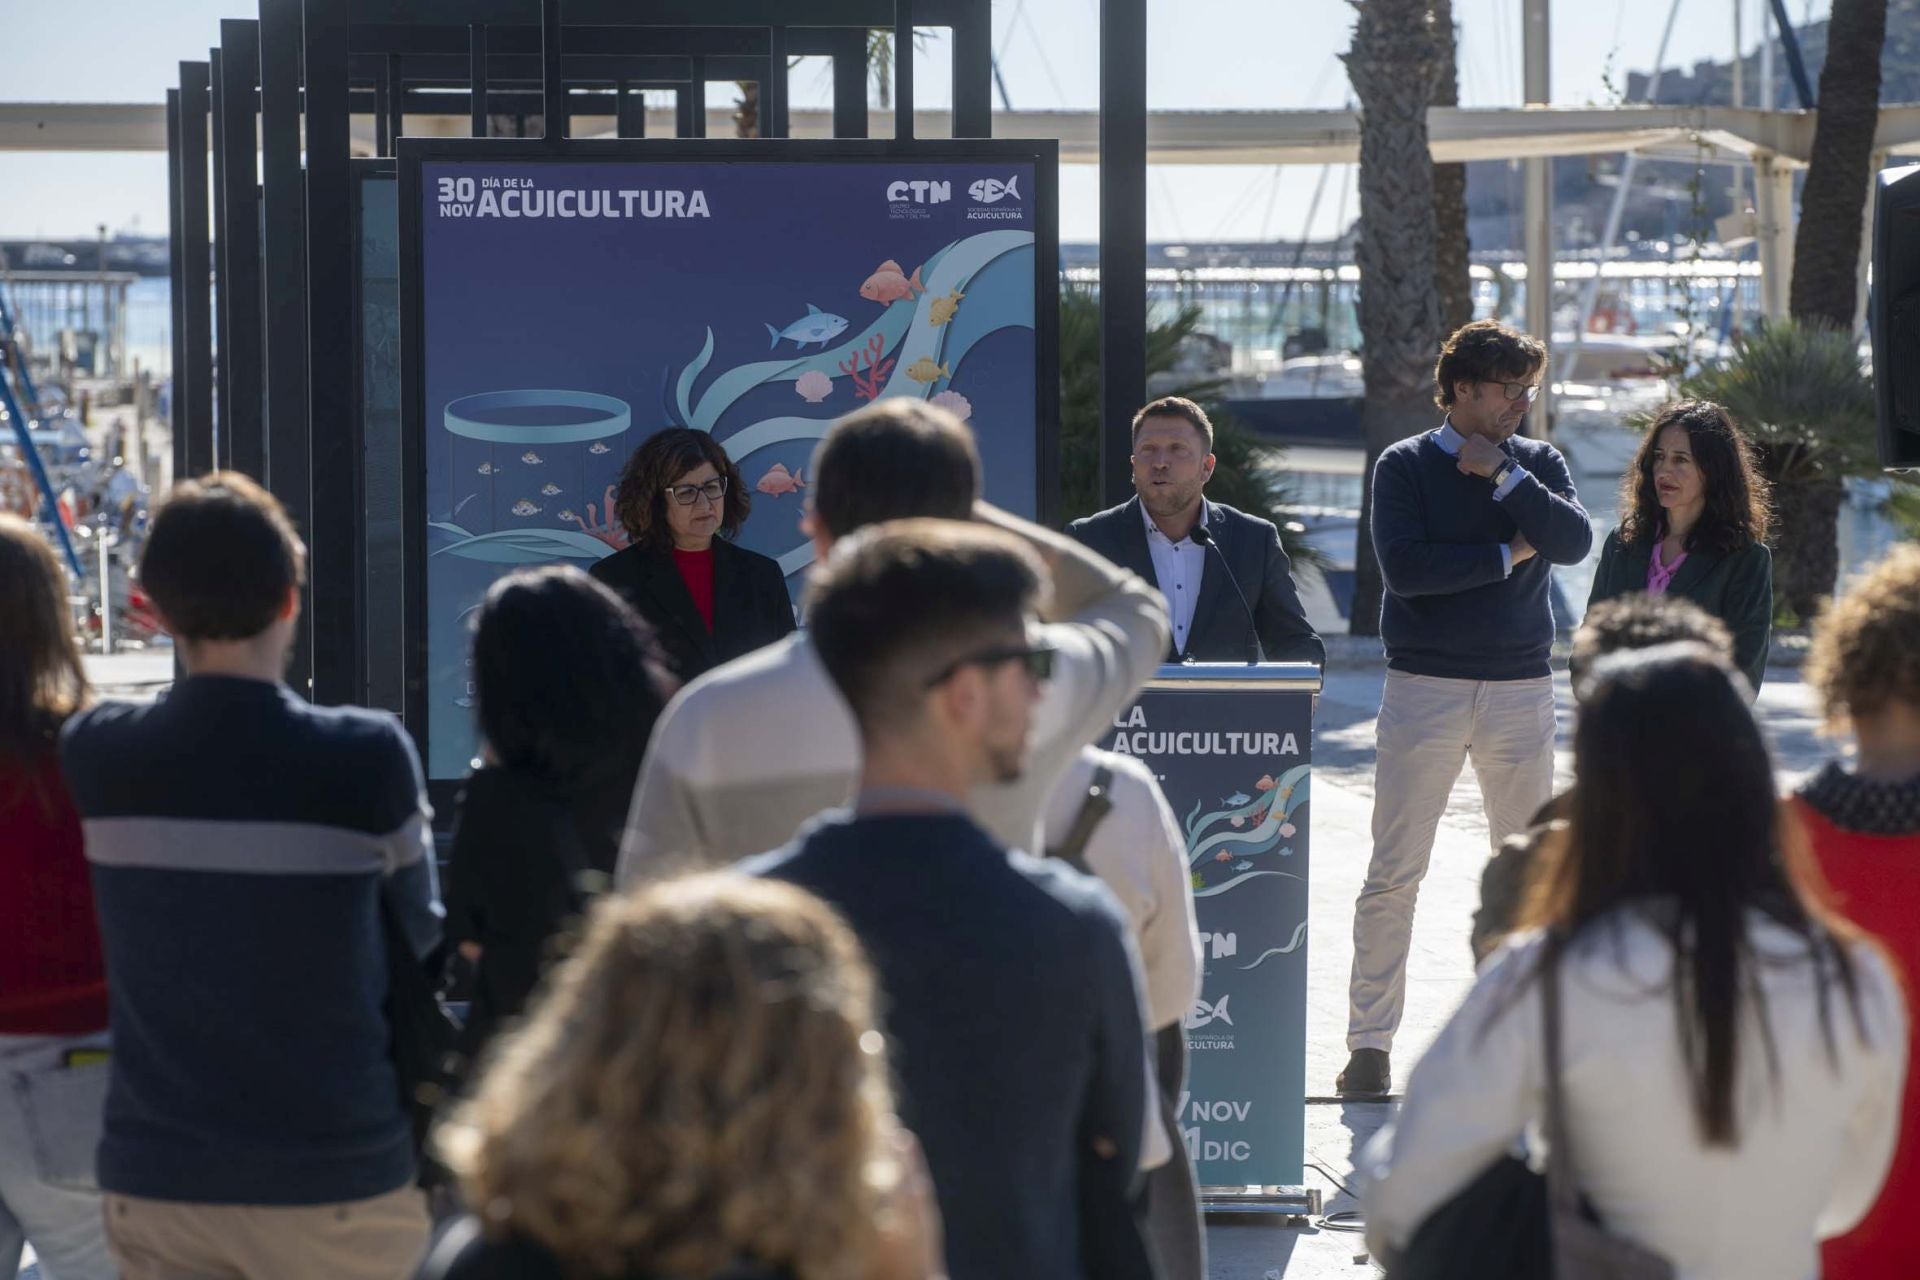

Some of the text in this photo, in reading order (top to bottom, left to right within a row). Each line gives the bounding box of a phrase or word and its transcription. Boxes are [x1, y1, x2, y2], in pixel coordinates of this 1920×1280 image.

[438, 177, 475, 202] 30
[481, 176, 534, 188] DÍA DE LA
[887, 181, 951, 204] CTN
[968, 175, 1021, 203] SEA
[439, 203, 474, 218] NOV
[476, 190, 711, 218] ACUICULTURA
[1112, 732, 1299, 755] ACUICULTURA
[1191, 1101, 1252, 1121] NOV
[1203, 1141, 1251, 1161] DIC
